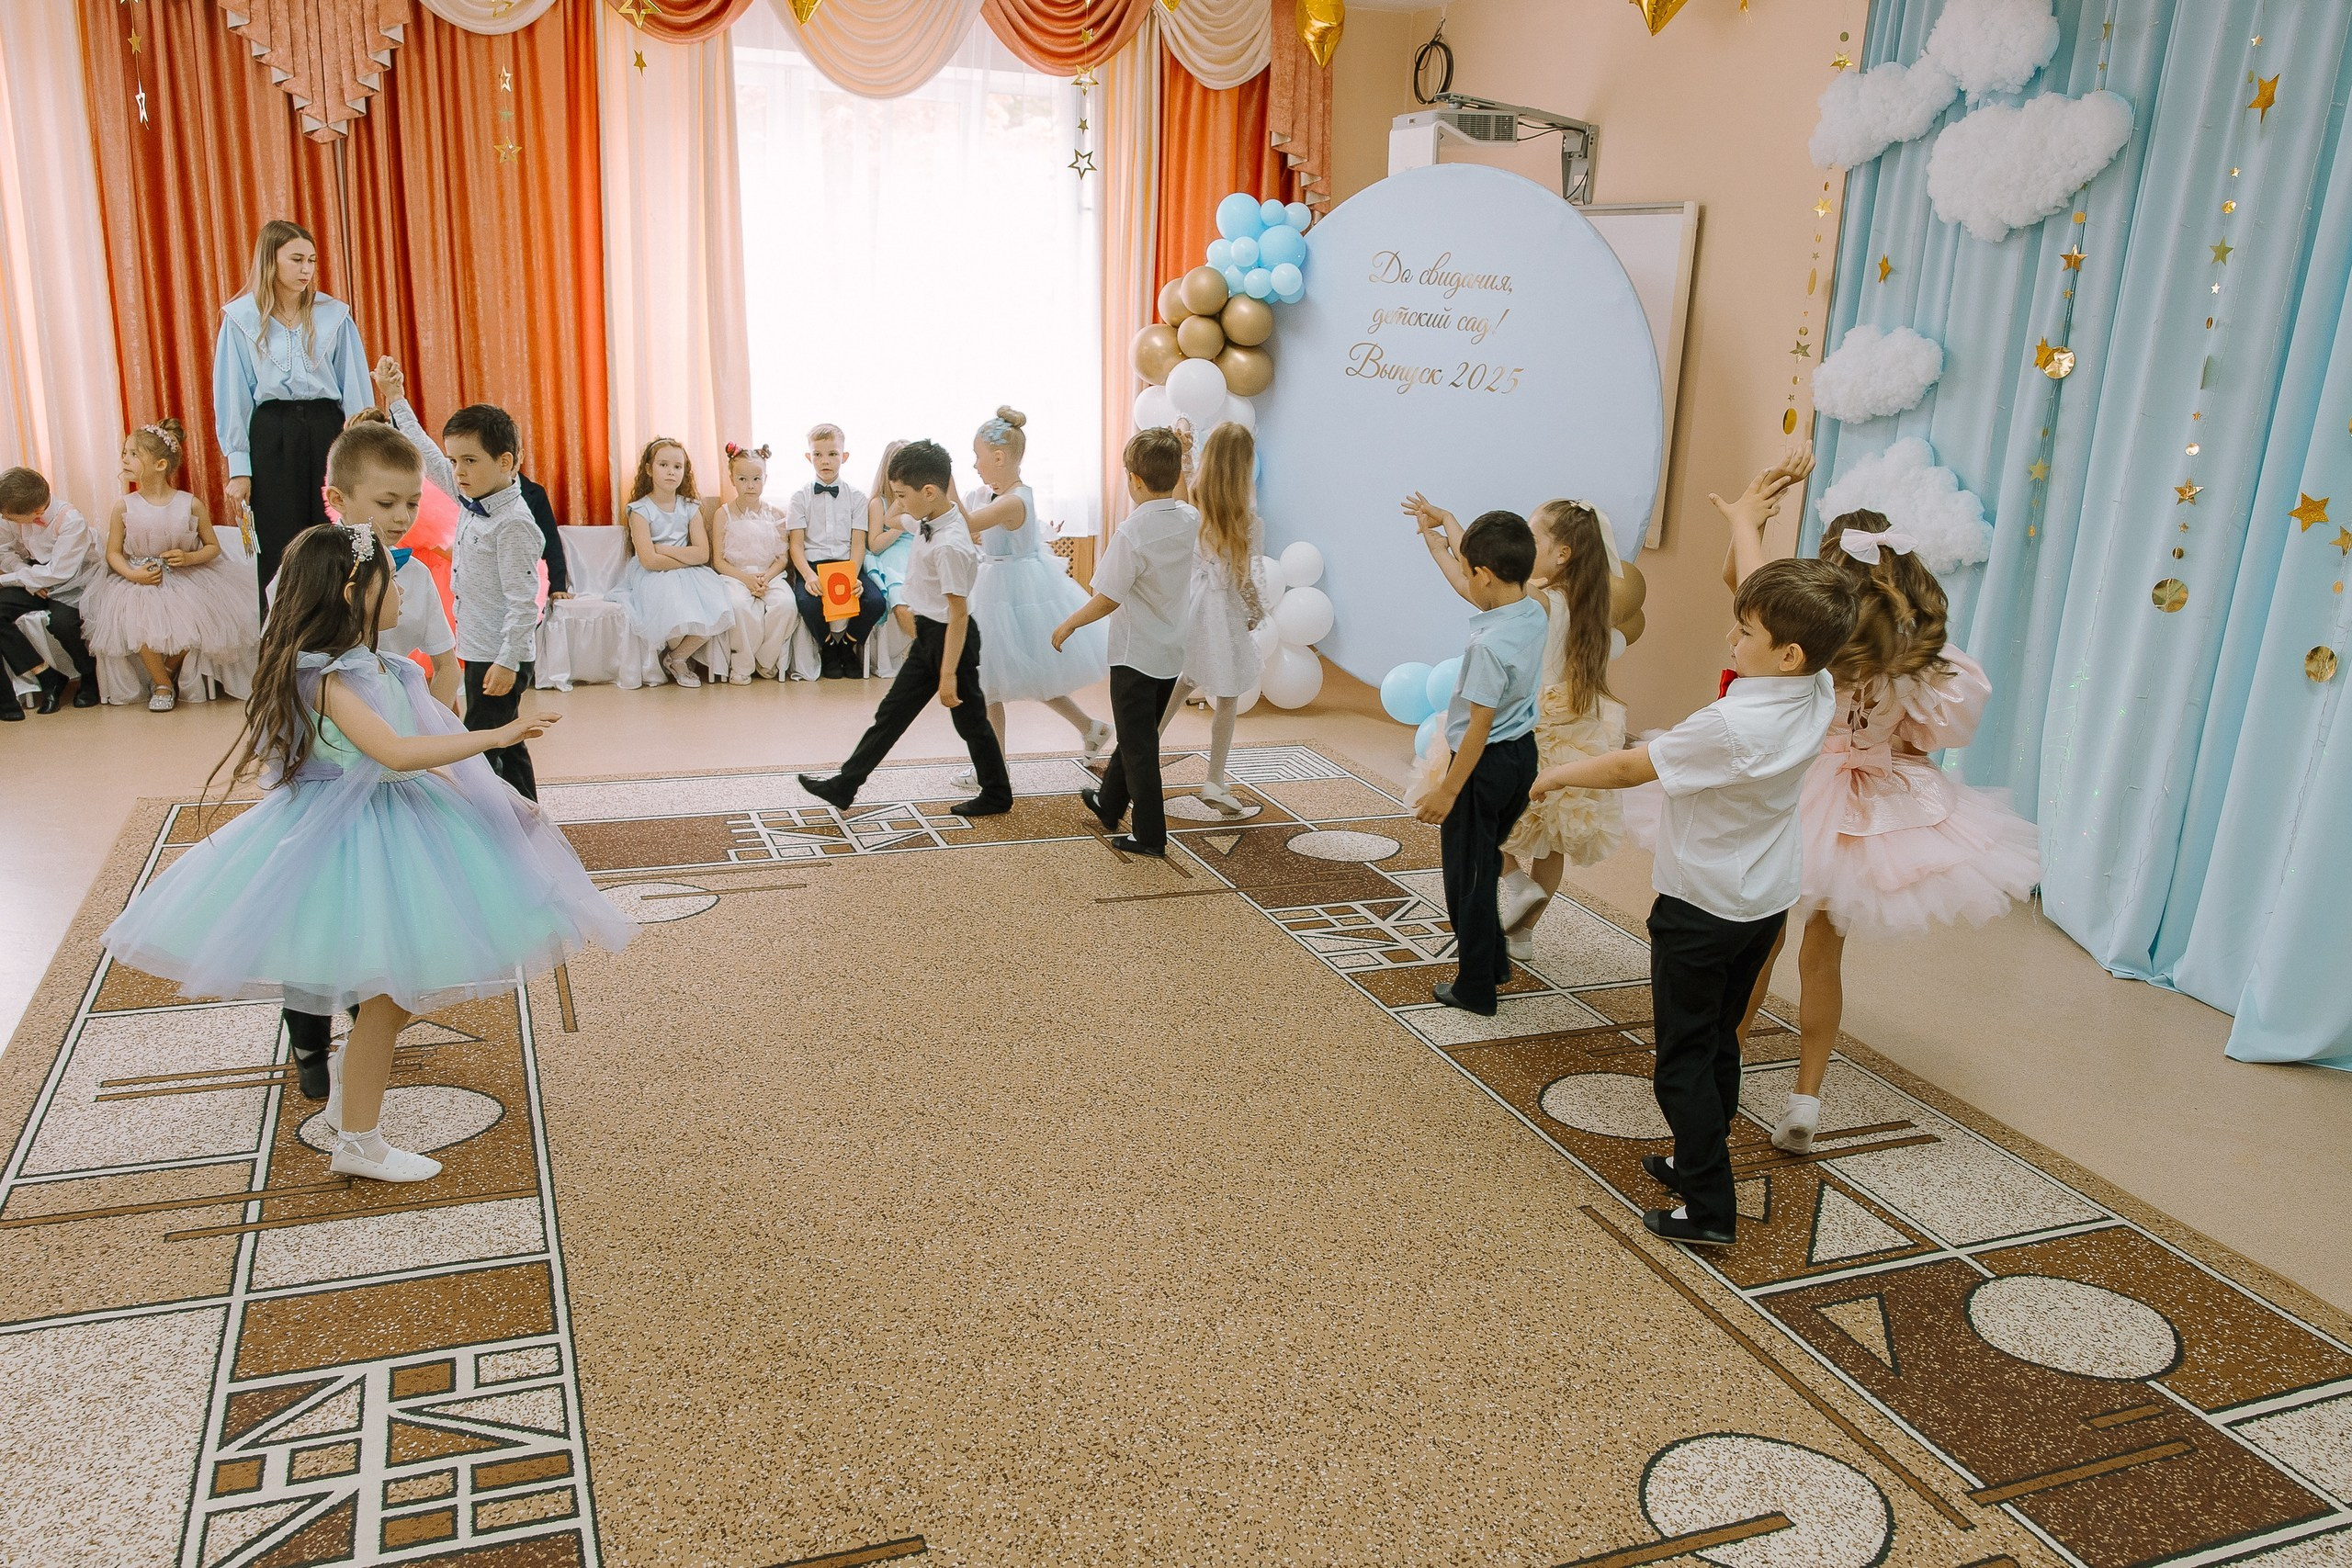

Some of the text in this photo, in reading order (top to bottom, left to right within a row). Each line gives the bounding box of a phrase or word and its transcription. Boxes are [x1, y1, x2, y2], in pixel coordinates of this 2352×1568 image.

[1369, 250, 1513, 299] До свидания,
[1367, 306, 1510, 344] детский сад!
[1345, 342, 1524, 394] Выпуск 2025
